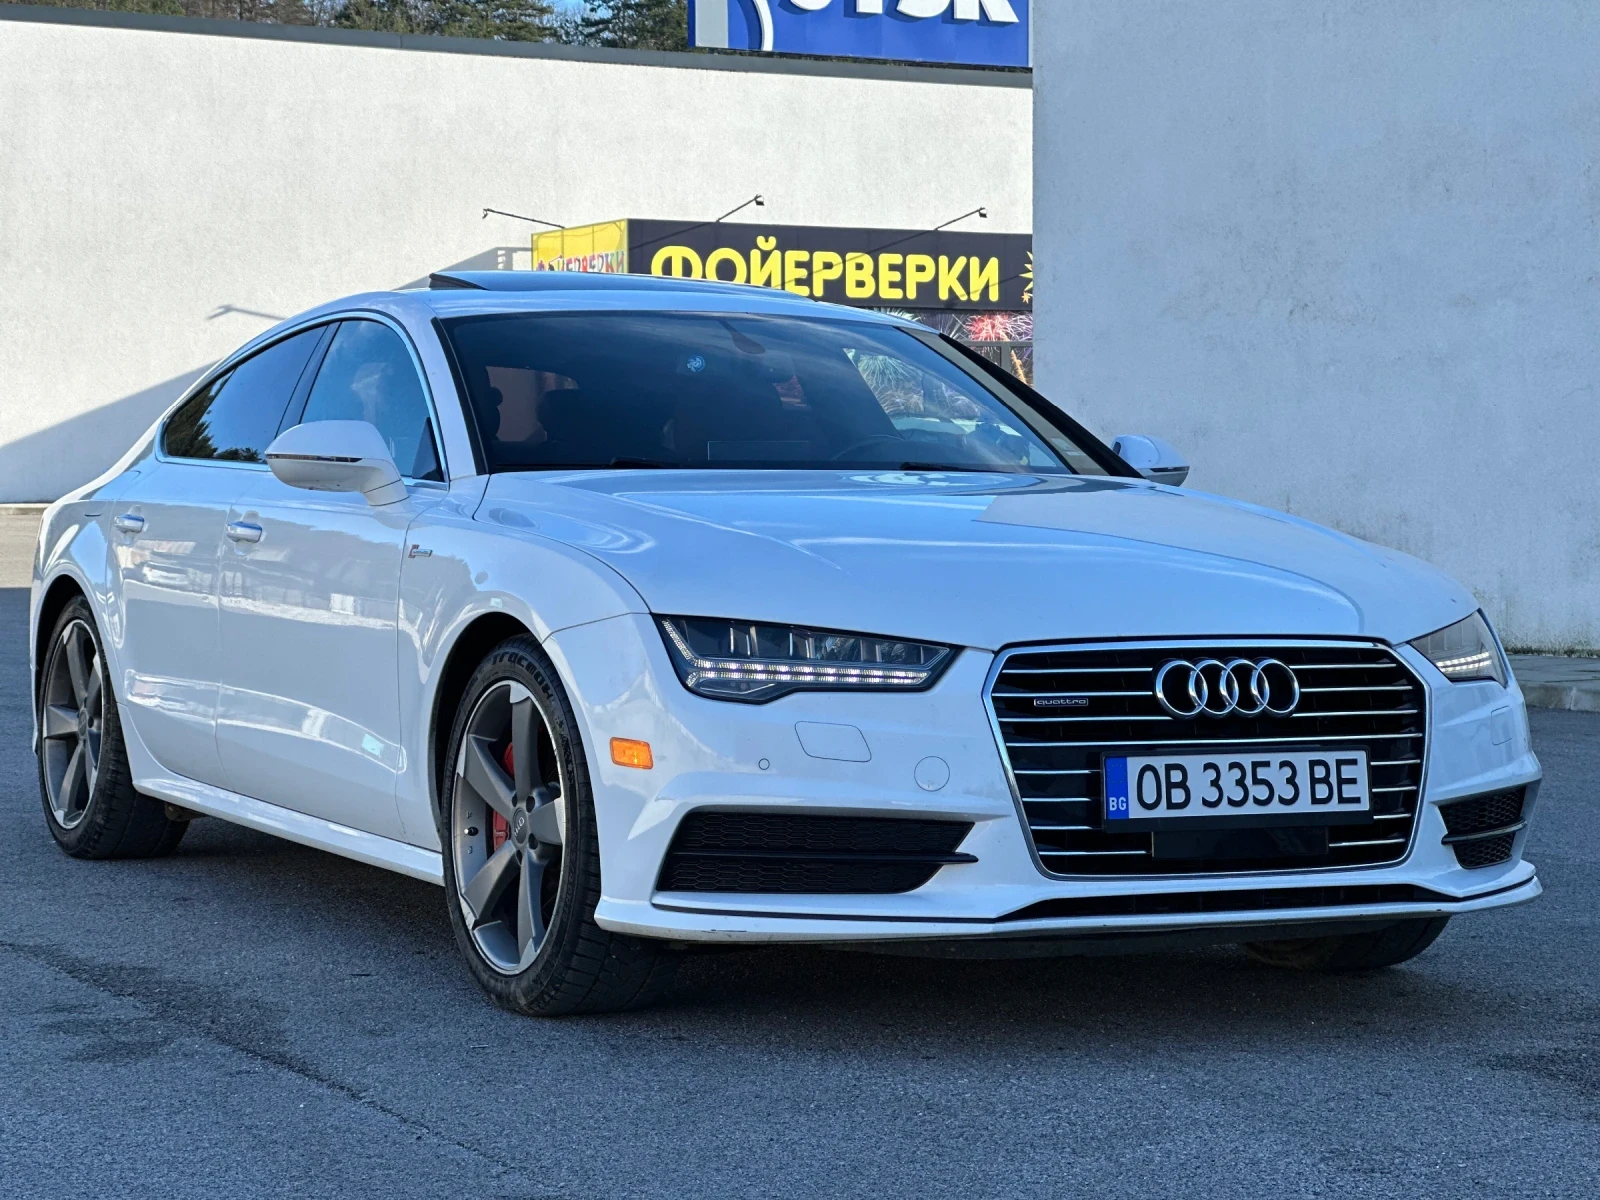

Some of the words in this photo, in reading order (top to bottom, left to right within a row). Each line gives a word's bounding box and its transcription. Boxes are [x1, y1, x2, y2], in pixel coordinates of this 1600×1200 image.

[651, 236, 999, 302] ФОЙЕРВЕРКИ
[1036, 698, 1087, 706] quattro
[1109, 796, 1127, 811] BG
[1136, 762, 1191, 811] OB
[1201, 760, 1300, 808] 3353
[1308, 758, 1361, 805] BE
